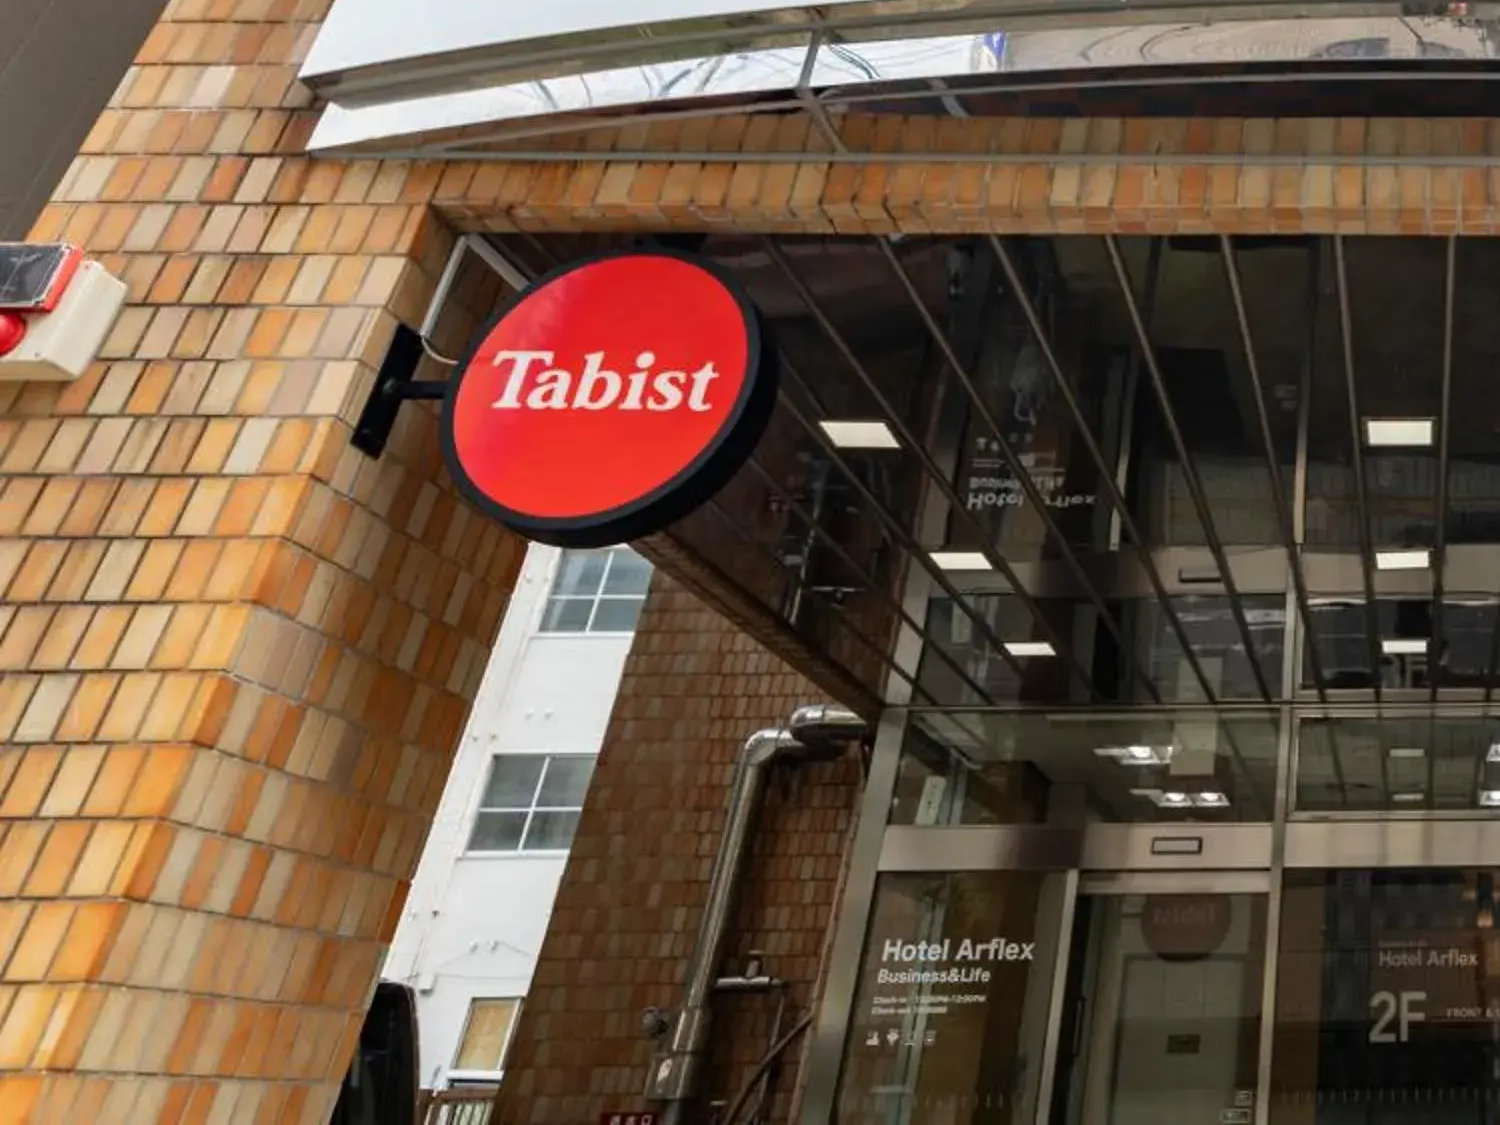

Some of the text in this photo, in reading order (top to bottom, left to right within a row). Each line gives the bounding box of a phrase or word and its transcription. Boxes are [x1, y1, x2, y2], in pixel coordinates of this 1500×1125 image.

[492, 350, 720, 412] Tabist
[881, 937, 1036, 962] Hotel Arflex
[1378, 947, 1479, 968] Hotel Arflex
[877, 967, 991, 984] Business&Life
[1368, 990, 1427, 1044] 2F
